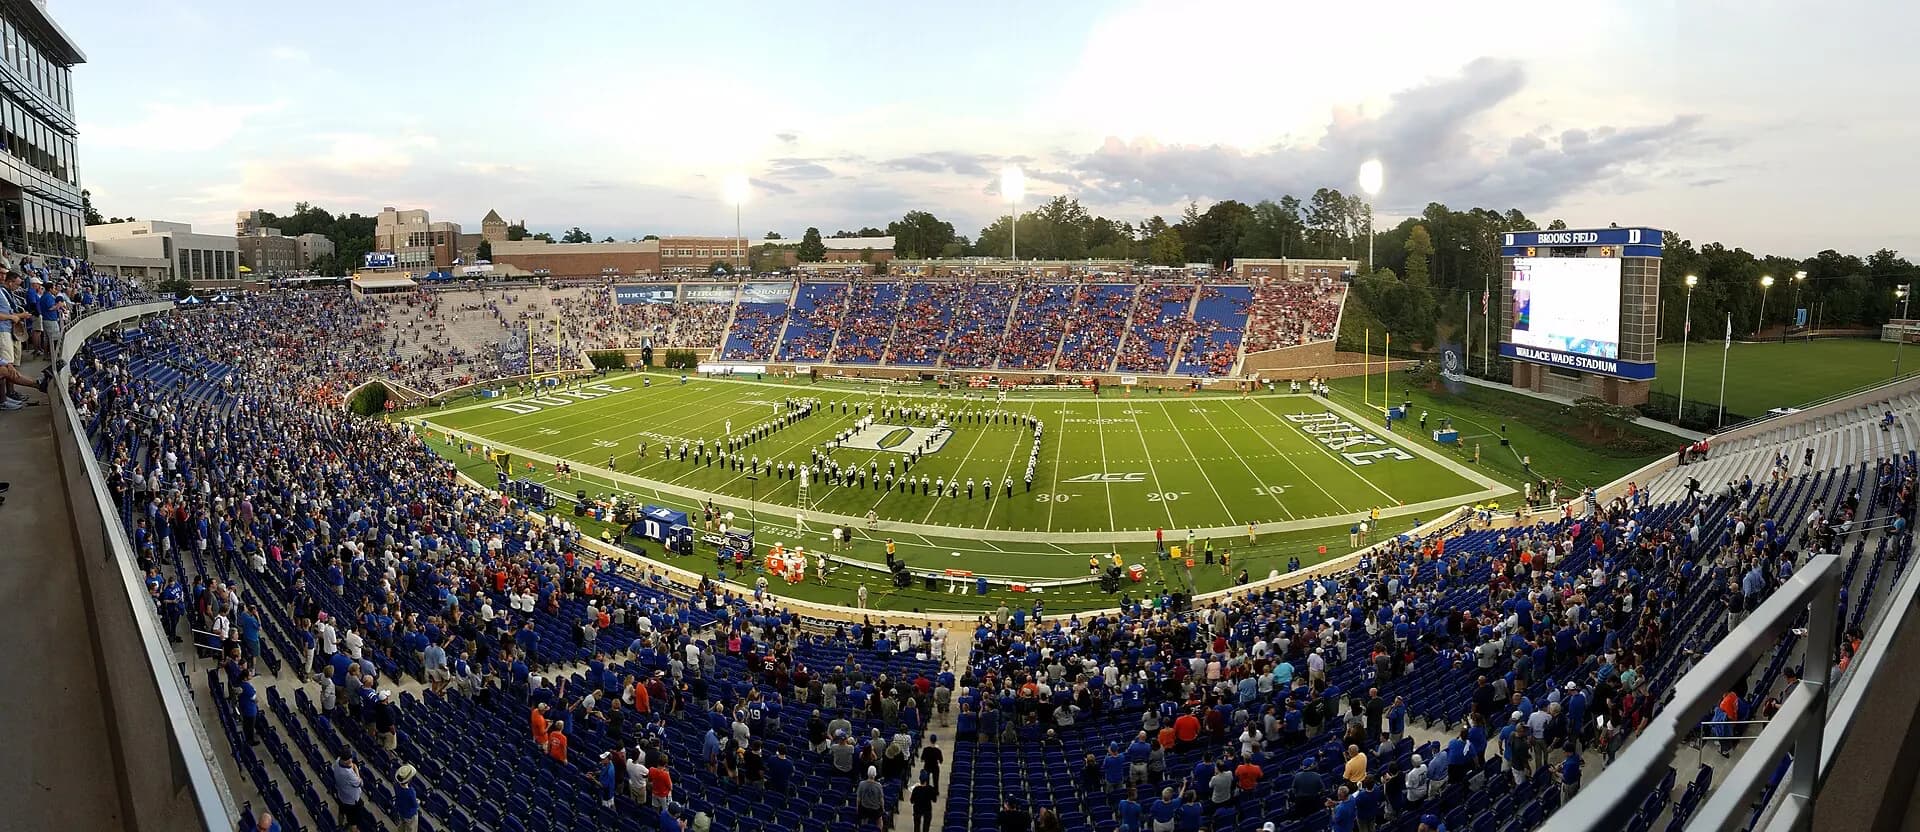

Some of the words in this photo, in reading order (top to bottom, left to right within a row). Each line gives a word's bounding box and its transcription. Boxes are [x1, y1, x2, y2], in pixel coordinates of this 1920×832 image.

[1505, 233, 1514, 246] D
[1538, 232, 1571, 244] BROOKS
[1572, 232, 1598, 243] FIELD
[1628, 229, 1641, 244] D
[1515, 347, 1550, 361] WALLACE
[1550, 352, 1576, 365] WADE
[1575, 356, 1617, 373] STADIUM
[491, 384, 632, 415] DUKE
[1283, 411, 1417, 467] DUKE
[1146, 492, 1179, 502] 20
[1252, 485, 1287, 497] 10
[1035, 493, 1070, 503] 30
[764, 661, 774, 671] 25
[1132, 690, 1139, 700] 3
[750, 709, 761, 720] 19
